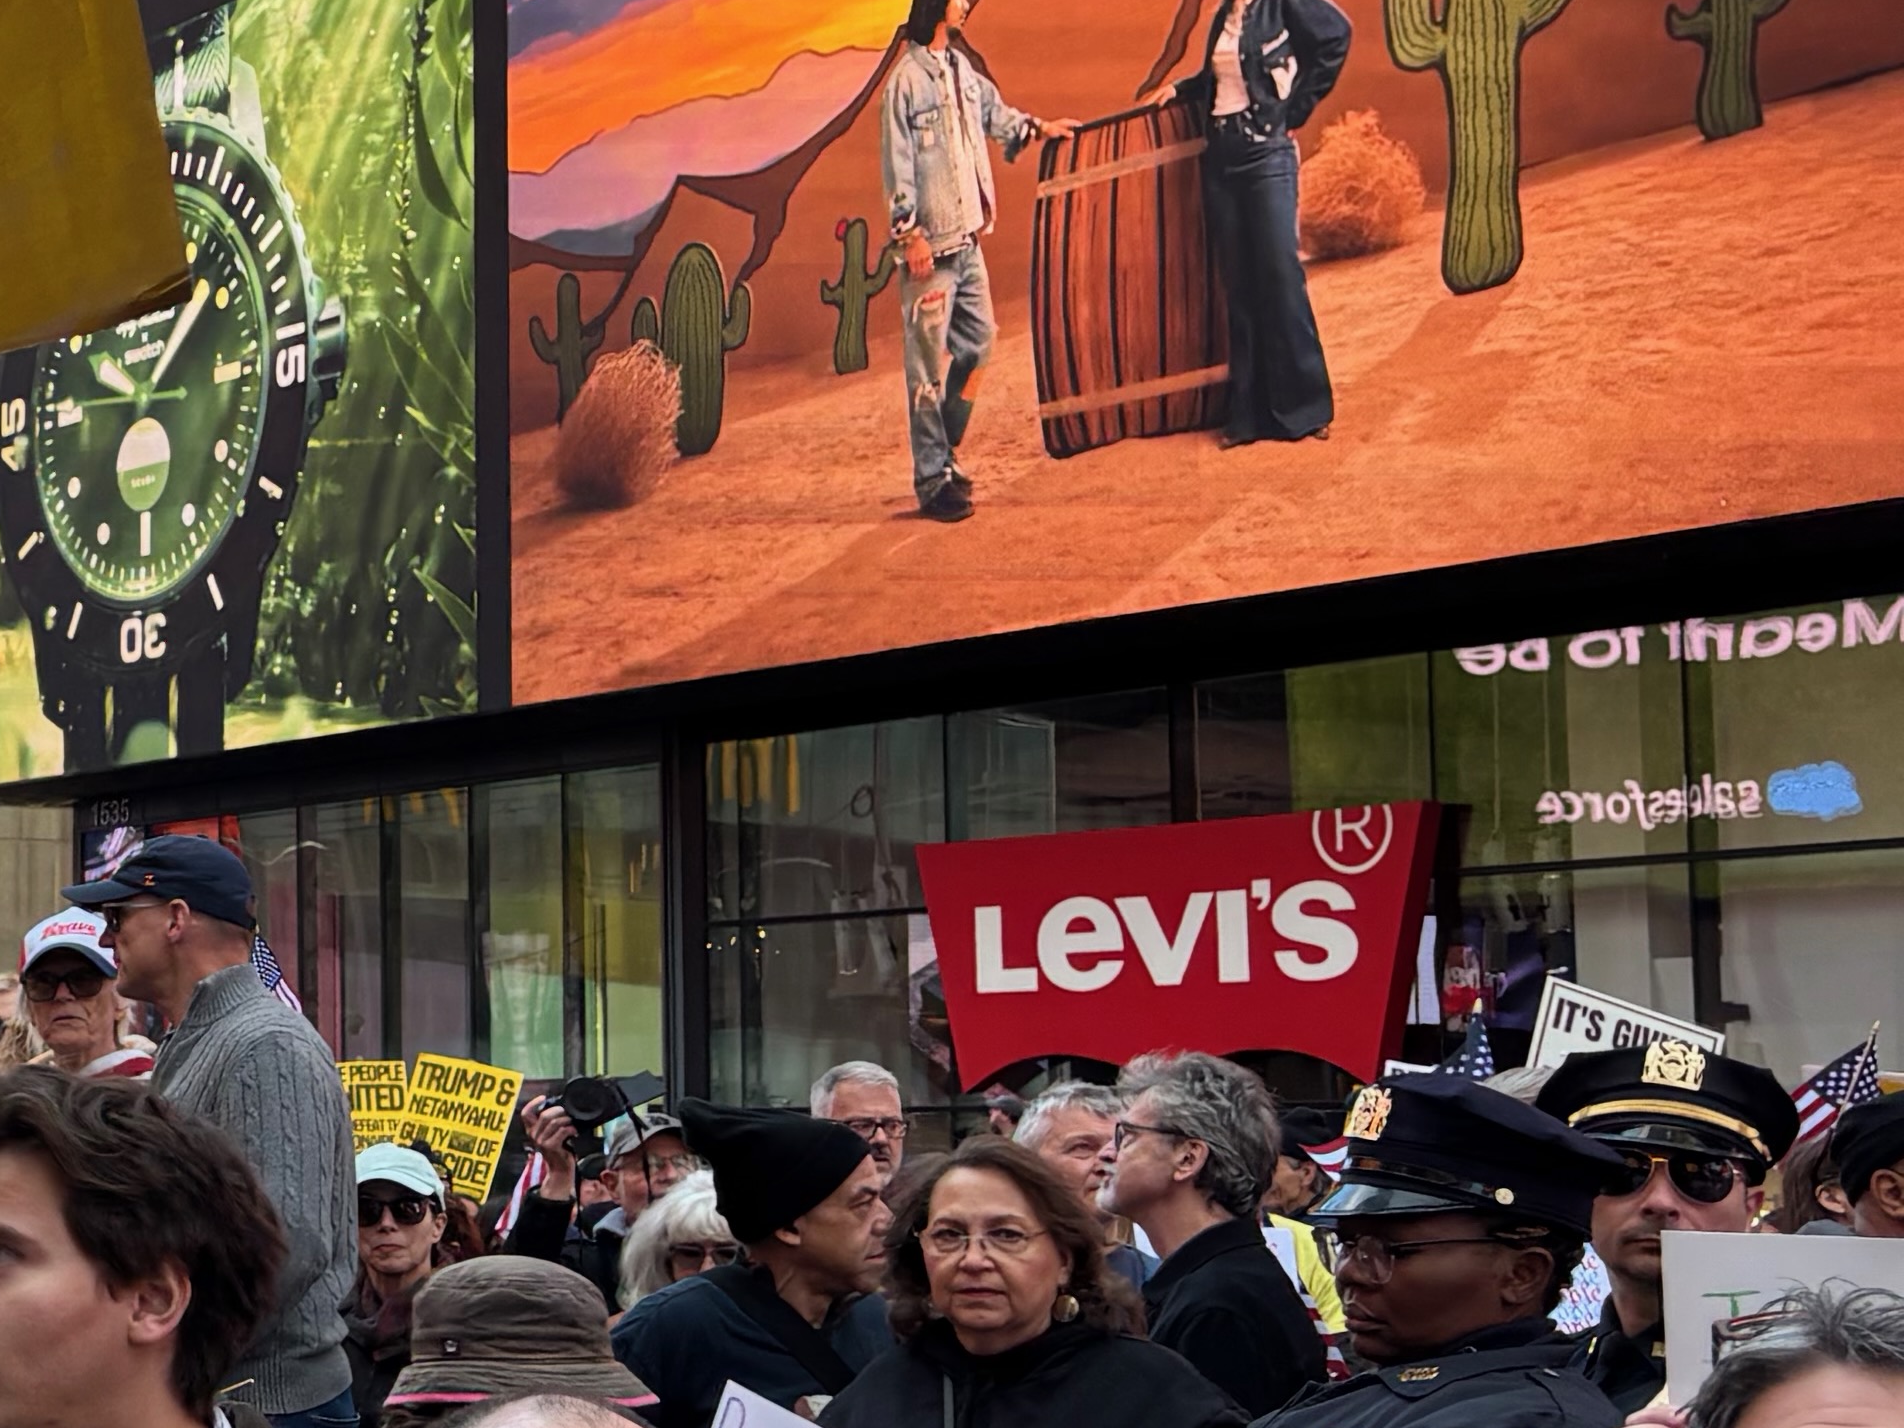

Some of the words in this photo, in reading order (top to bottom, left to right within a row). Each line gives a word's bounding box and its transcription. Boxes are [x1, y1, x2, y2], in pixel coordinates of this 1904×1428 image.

[92, 798, 130, 827] 1535
[1552, 998, 1605, 1042] IT'S
[350, 1064, 404, 1082] PEOPLE
[417, 1061, 495, 1101] TRUMP
[495, 1078, 516, 1107] &
[350, 1084, 404, 1112] ITED
[399, 1121, 450, 1147] GUILTY
[476, 1136, 500, 1158] OF
